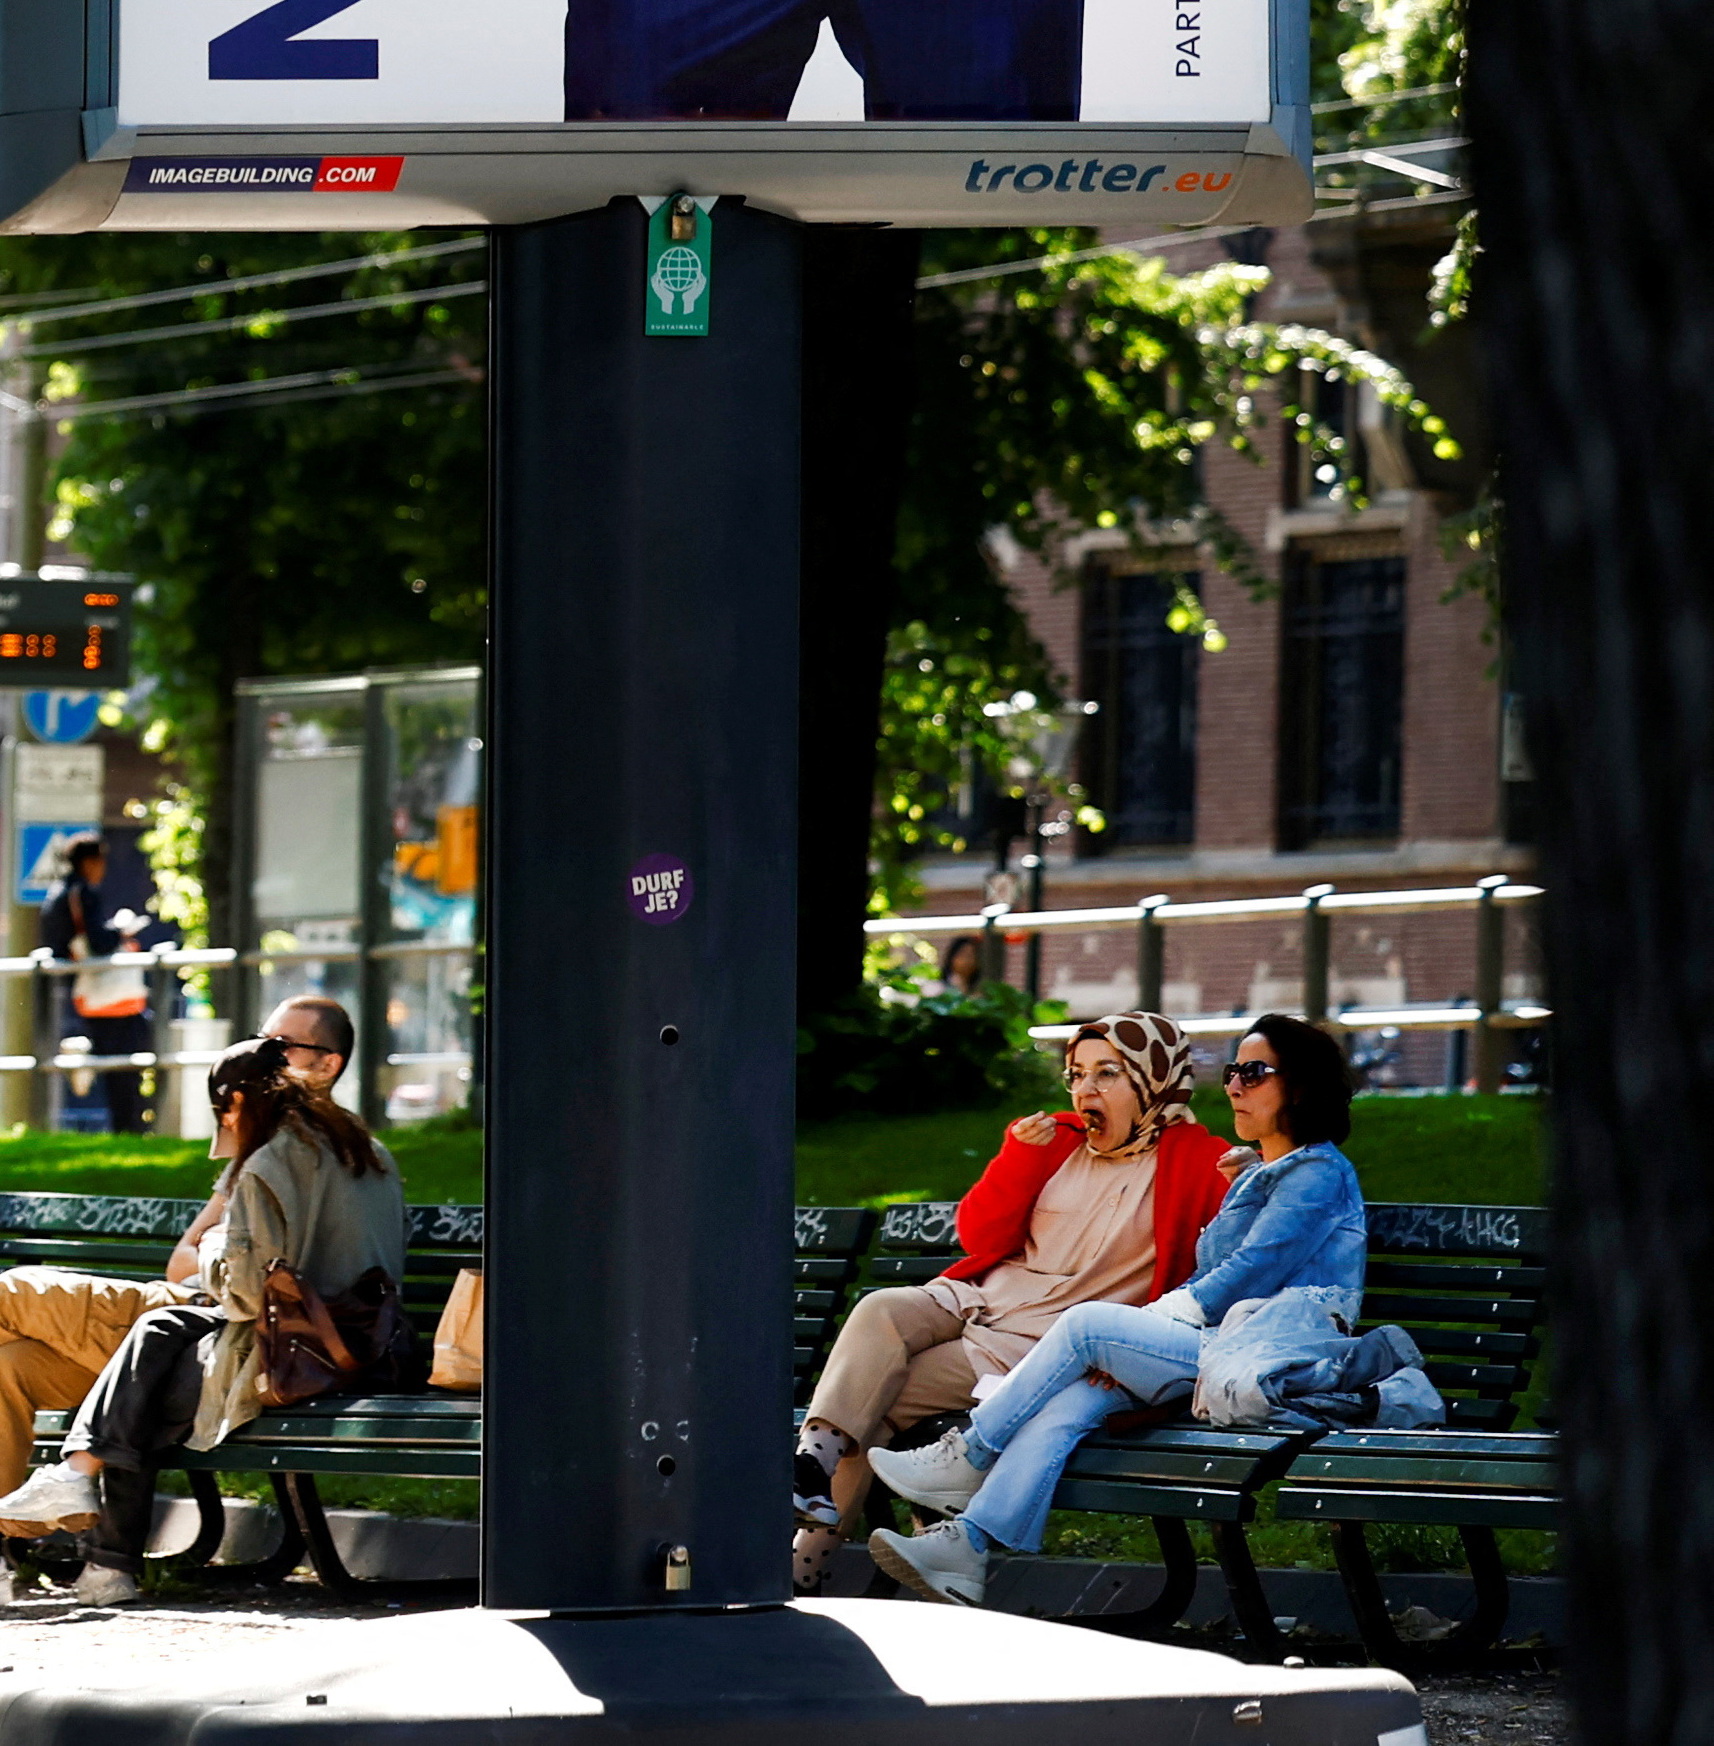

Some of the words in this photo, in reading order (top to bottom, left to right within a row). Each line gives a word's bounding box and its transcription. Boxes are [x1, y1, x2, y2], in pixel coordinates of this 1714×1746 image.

[964, 158, 1233, 194] trotter.eu
[632, 868, 684, 896] DURF
[644, 889, 679, 914] JE?
